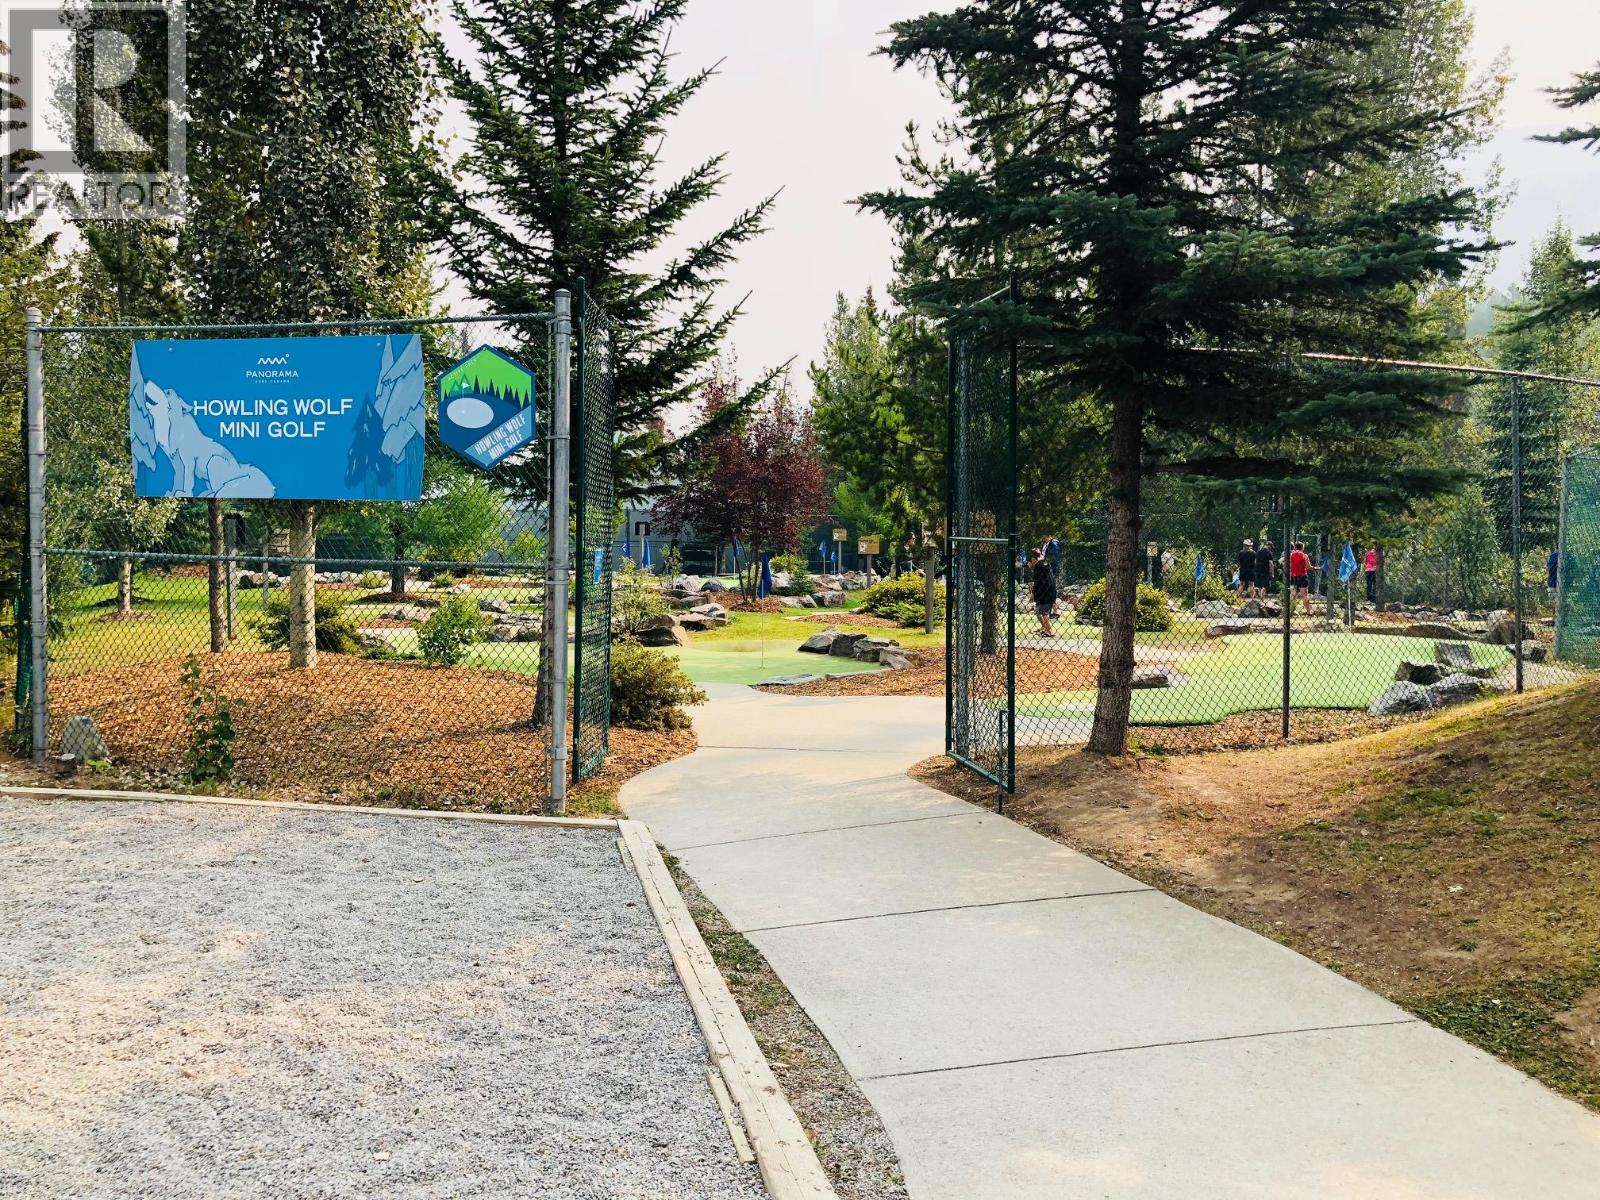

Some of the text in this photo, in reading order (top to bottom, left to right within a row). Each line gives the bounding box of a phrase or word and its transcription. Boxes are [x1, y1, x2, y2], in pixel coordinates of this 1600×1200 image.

[246, 370, 299, 379] PANORAMA
[193, 398, 353, 416] HOWLING WOLF
[220, 421, 325, 438] MINI GOLF
[474, 413, 526, 455] HOWLING WOLF
[488, 430, 522, 461] MINI-GOLF
